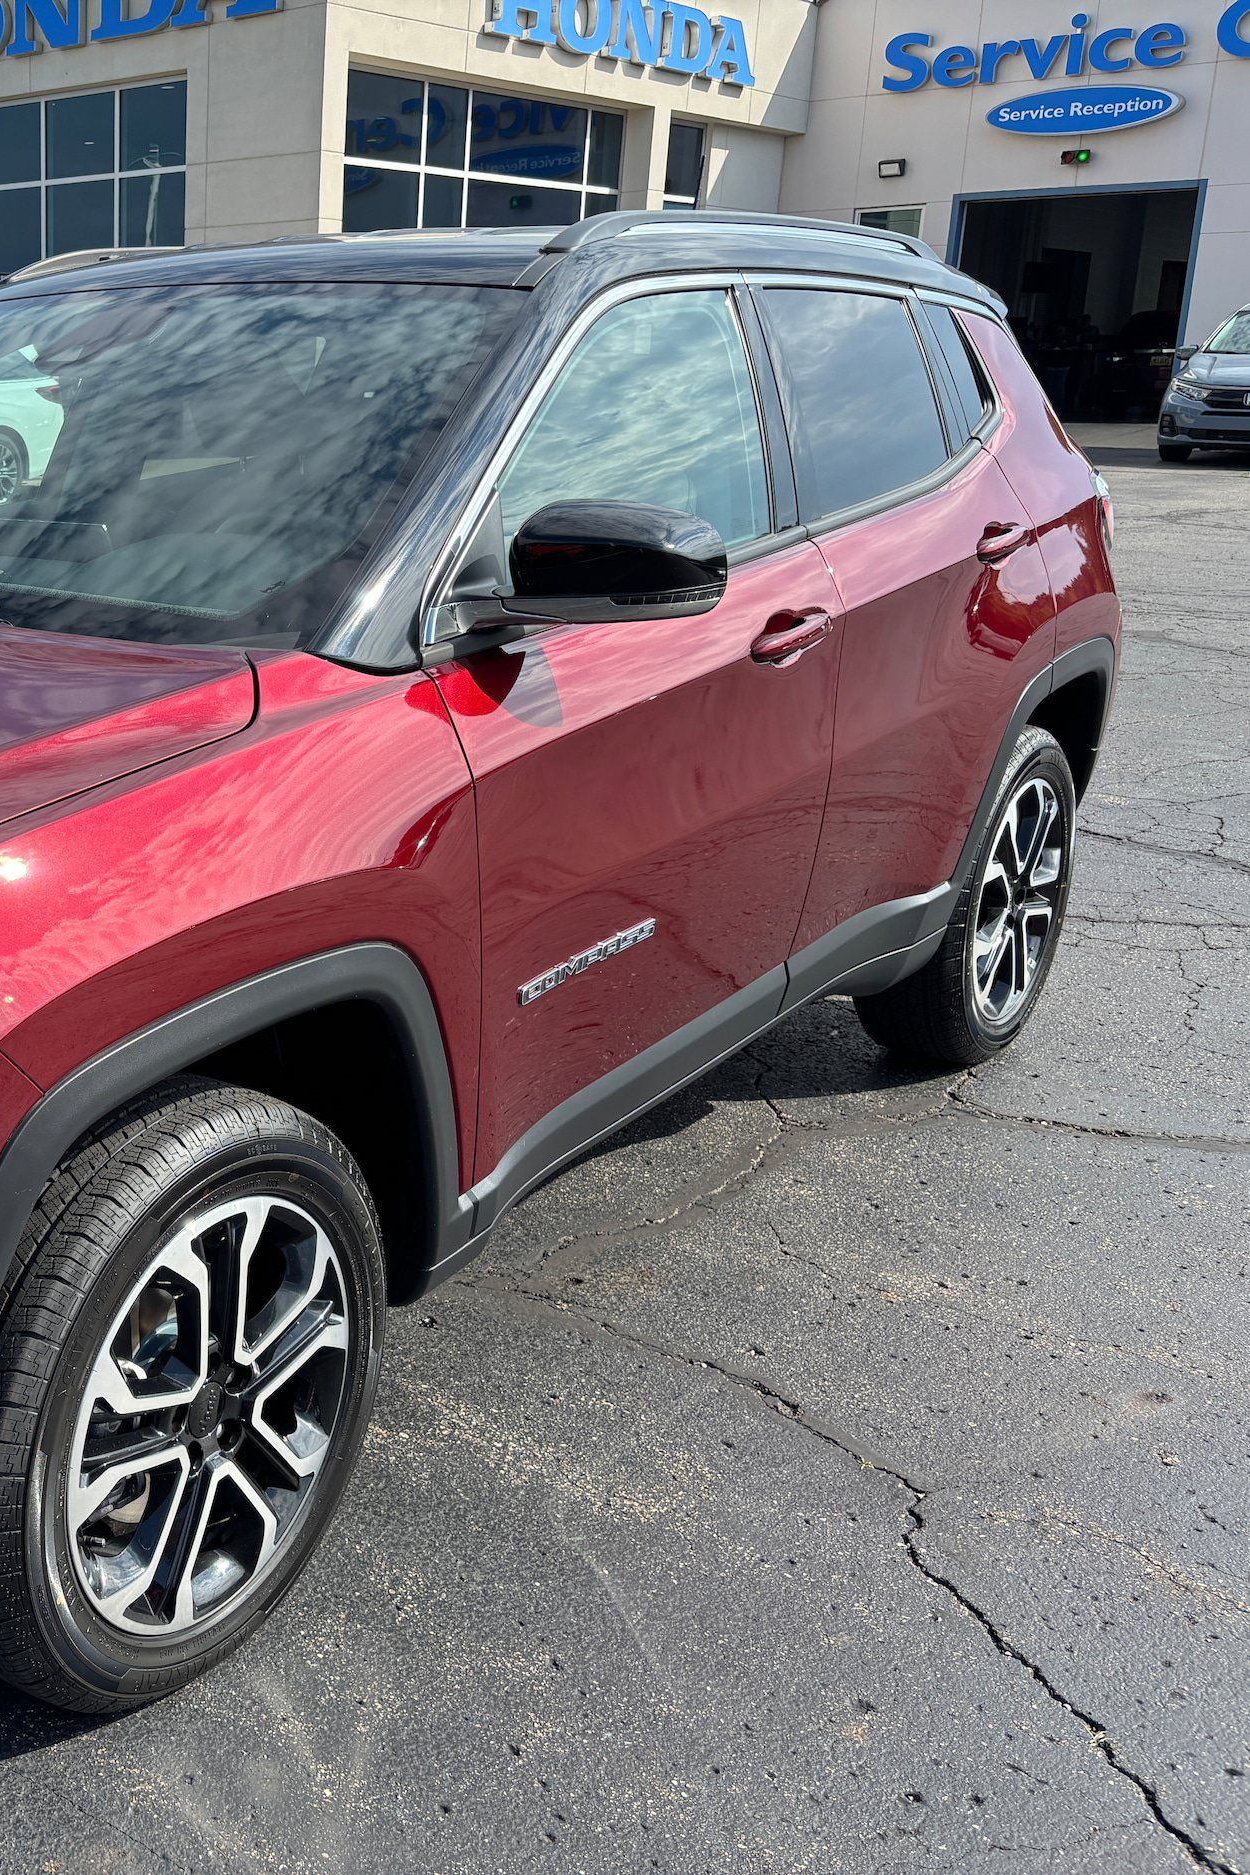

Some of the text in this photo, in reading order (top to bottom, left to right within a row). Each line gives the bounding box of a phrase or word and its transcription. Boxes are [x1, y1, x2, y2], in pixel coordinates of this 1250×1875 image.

[488, 0, 756, 87] HONDA
[882, 13, 1187, 93] Service
[998, 96, 1164, 123] Service Reception
[517, 917, 657, 1006] COMPASS
